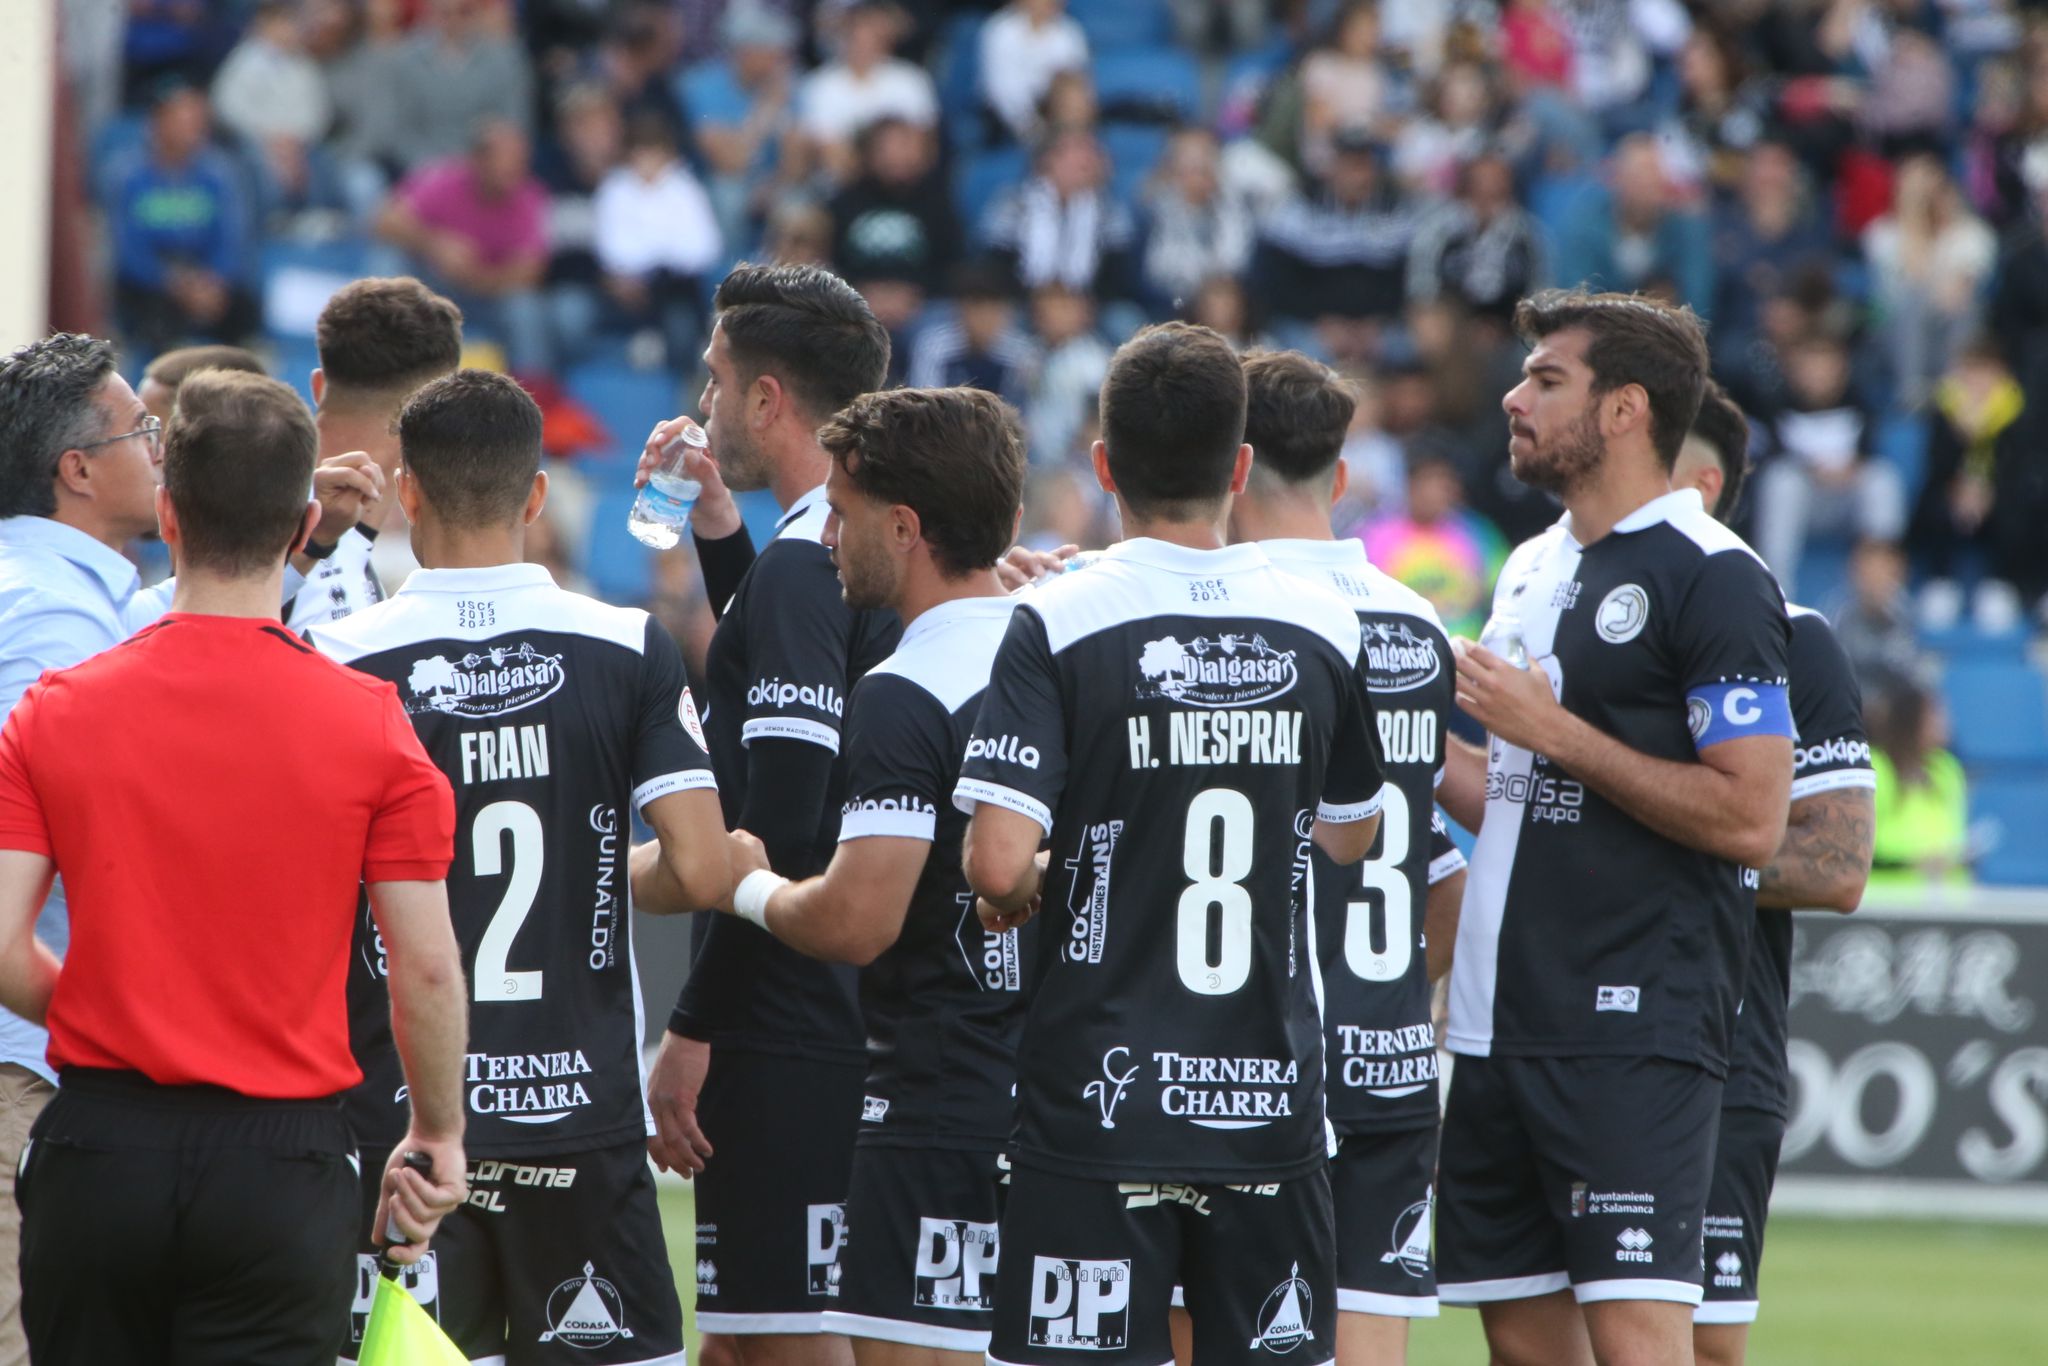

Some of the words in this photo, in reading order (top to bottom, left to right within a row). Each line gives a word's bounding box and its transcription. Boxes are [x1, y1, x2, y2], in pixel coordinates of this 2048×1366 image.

[457, 600, 495, 611] USCF
[459, 608, 495, 619] 2013
[459, 617, 495, 629] 2023
[452, 661, 552, 697] Dialgasa
[1182, 655, 1283, 687] Dialgasa
[1723, 687, 1763, 726] C
[460, 724, 551, 785] FRAN
[1126, 715, 1160, 770] H.
[589, 803, 618, 970] GUINALDO
[1176, 787, 1255, 996] 8
[1343, 781, 1412, 982] 3
[472, 800, 544, 1002] 2
[1337, 1022, 1436, 1055] TERNERA
[464, 1050, 592, 1082] TERNERA
[1153, 1052, 1298, 1084] TERNERA
[1342, 1053, 1439, 1088] CHARRA
[469, 1082, 591, 1113] CHARRA
[1161, 1085, 1292, 1117] CHARRA
[1588, 1191, 1655, 1204] Ayuntamiento
[1588, 1203, 1601, 1214] de
[1602, 1203, 1654, 1214] Salamanca
[1615, 1250, 1653, 1263] errea
[562, 1280, 582, 1293] AUTO
[1093, 1266, 1125, 1283] Peña
[564, 1320, 612, 1330] CODASA
[1269, 1322, 1301, 1335] CODASA
